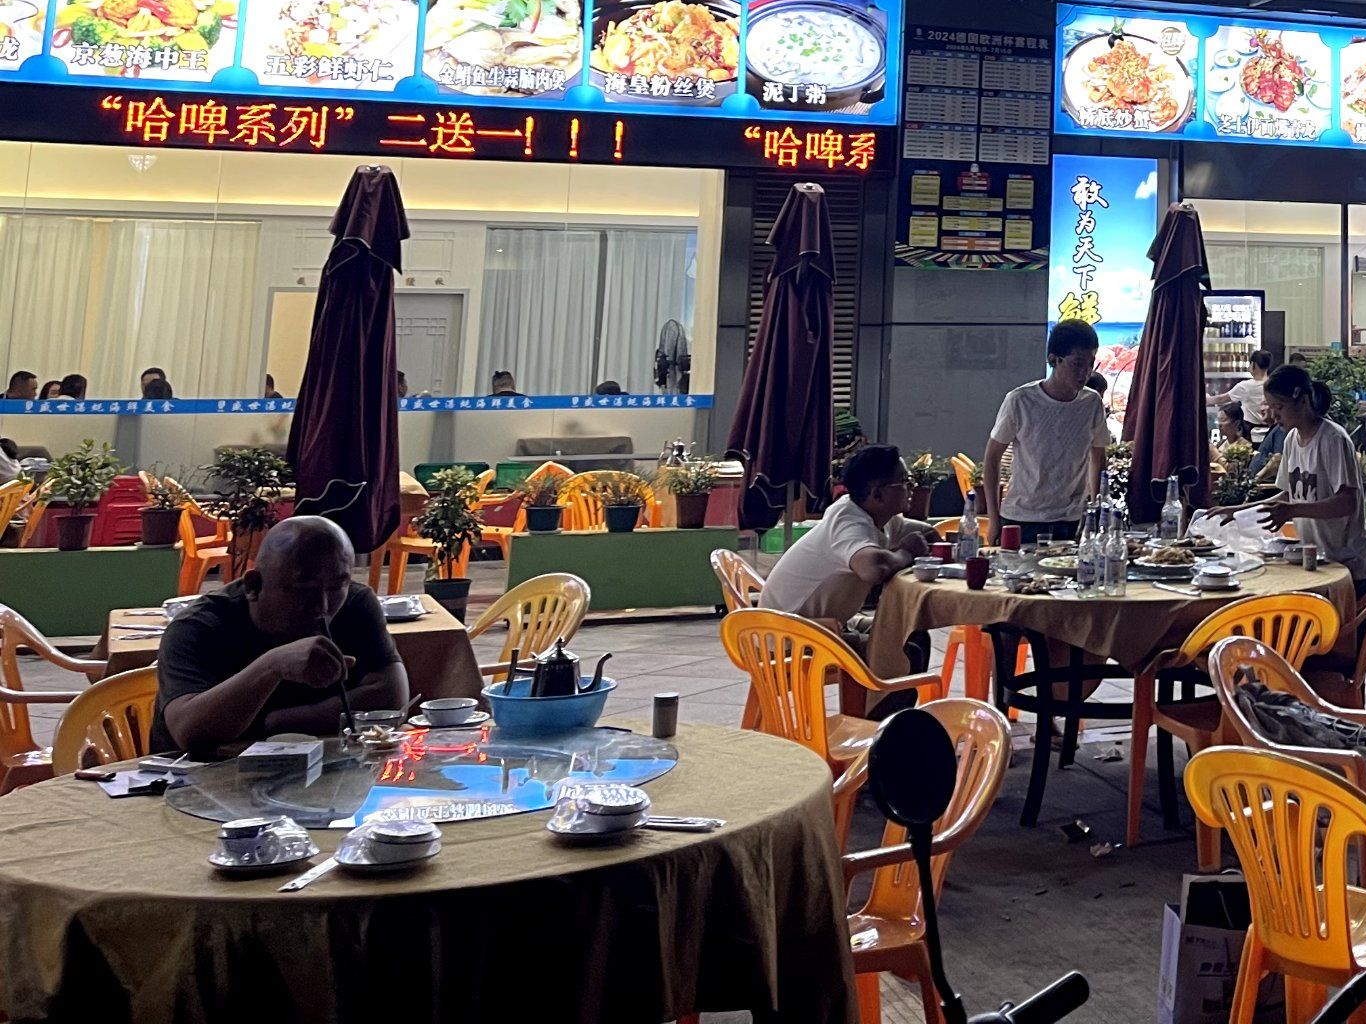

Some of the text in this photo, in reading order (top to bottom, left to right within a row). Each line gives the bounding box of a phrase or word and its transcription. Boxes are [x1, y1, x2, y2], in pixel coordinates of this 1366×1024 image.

[264, 55, 395, 82] 五彩鲜虾仁
[604, 72, 716, 99] 海皇粉丝煲
[762, 81, 828, 105] 泥丁粥
